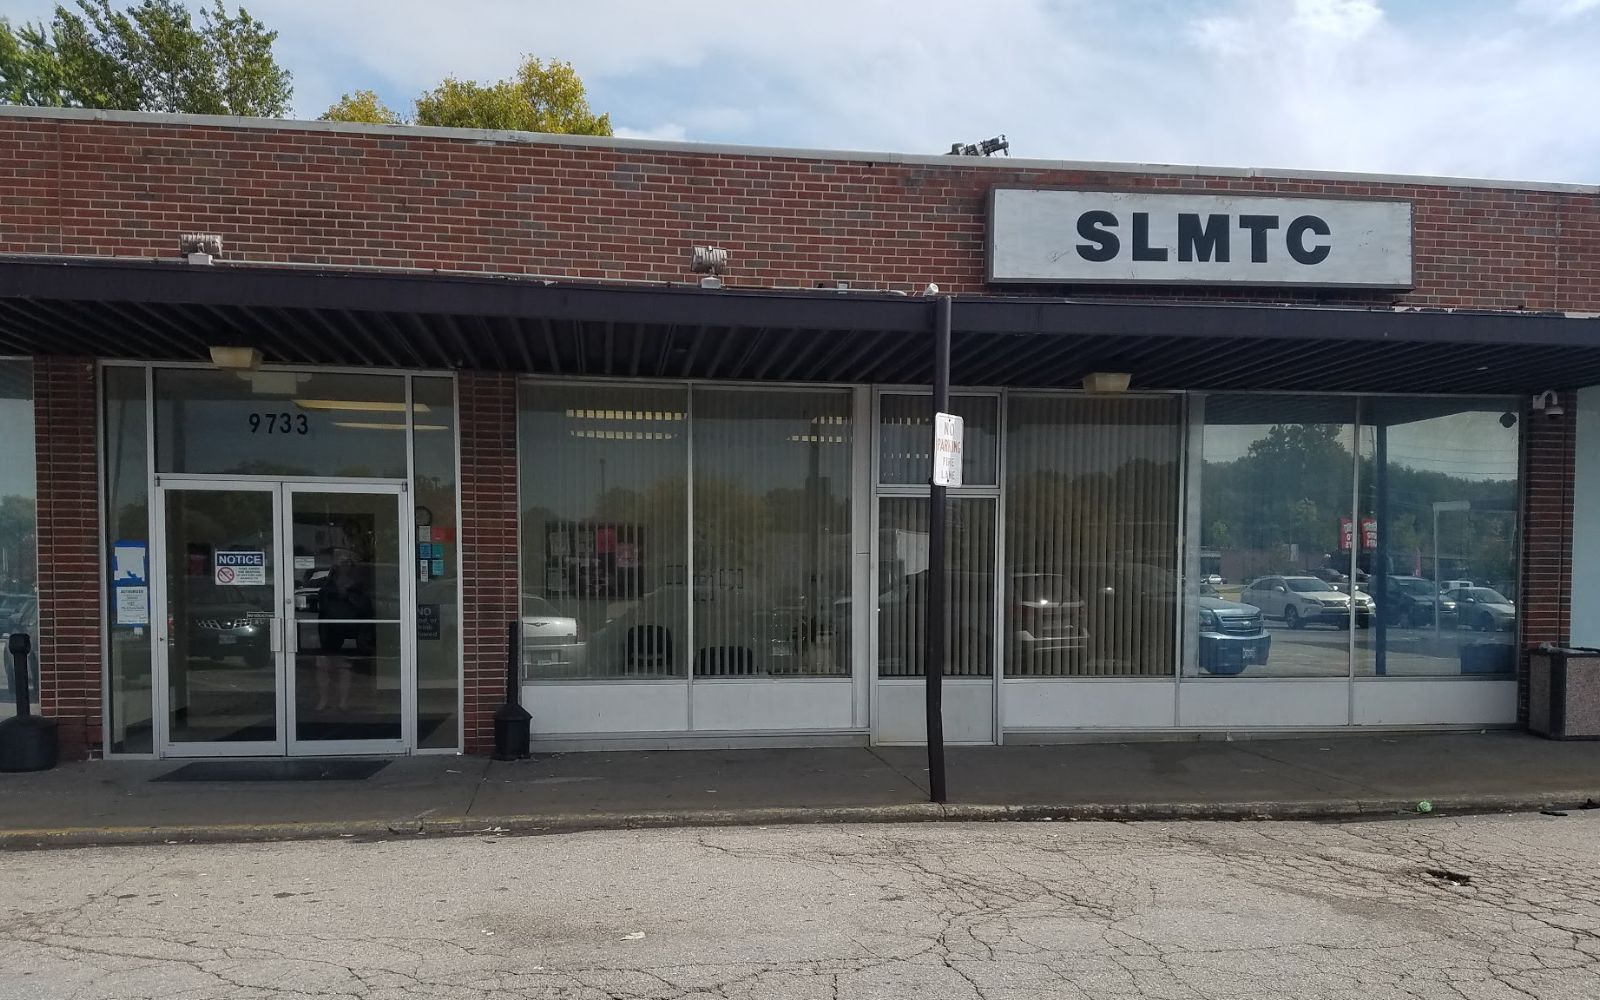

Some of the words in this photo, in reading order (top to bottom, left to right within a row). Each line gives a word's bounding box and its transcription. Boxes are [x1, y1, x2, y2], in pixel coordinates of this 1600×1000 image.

[1076, 209, 1332, 265] SLMTC
[249, 413, 309, 435] 9733
[944, 422, 954, 436] NO
[937, 438, 960, 454] PARKING
[942, 456, 955, 467] FIRE
[941, 469, 956, 480] LANE
[218, 555, 262, 565] NOTICE
